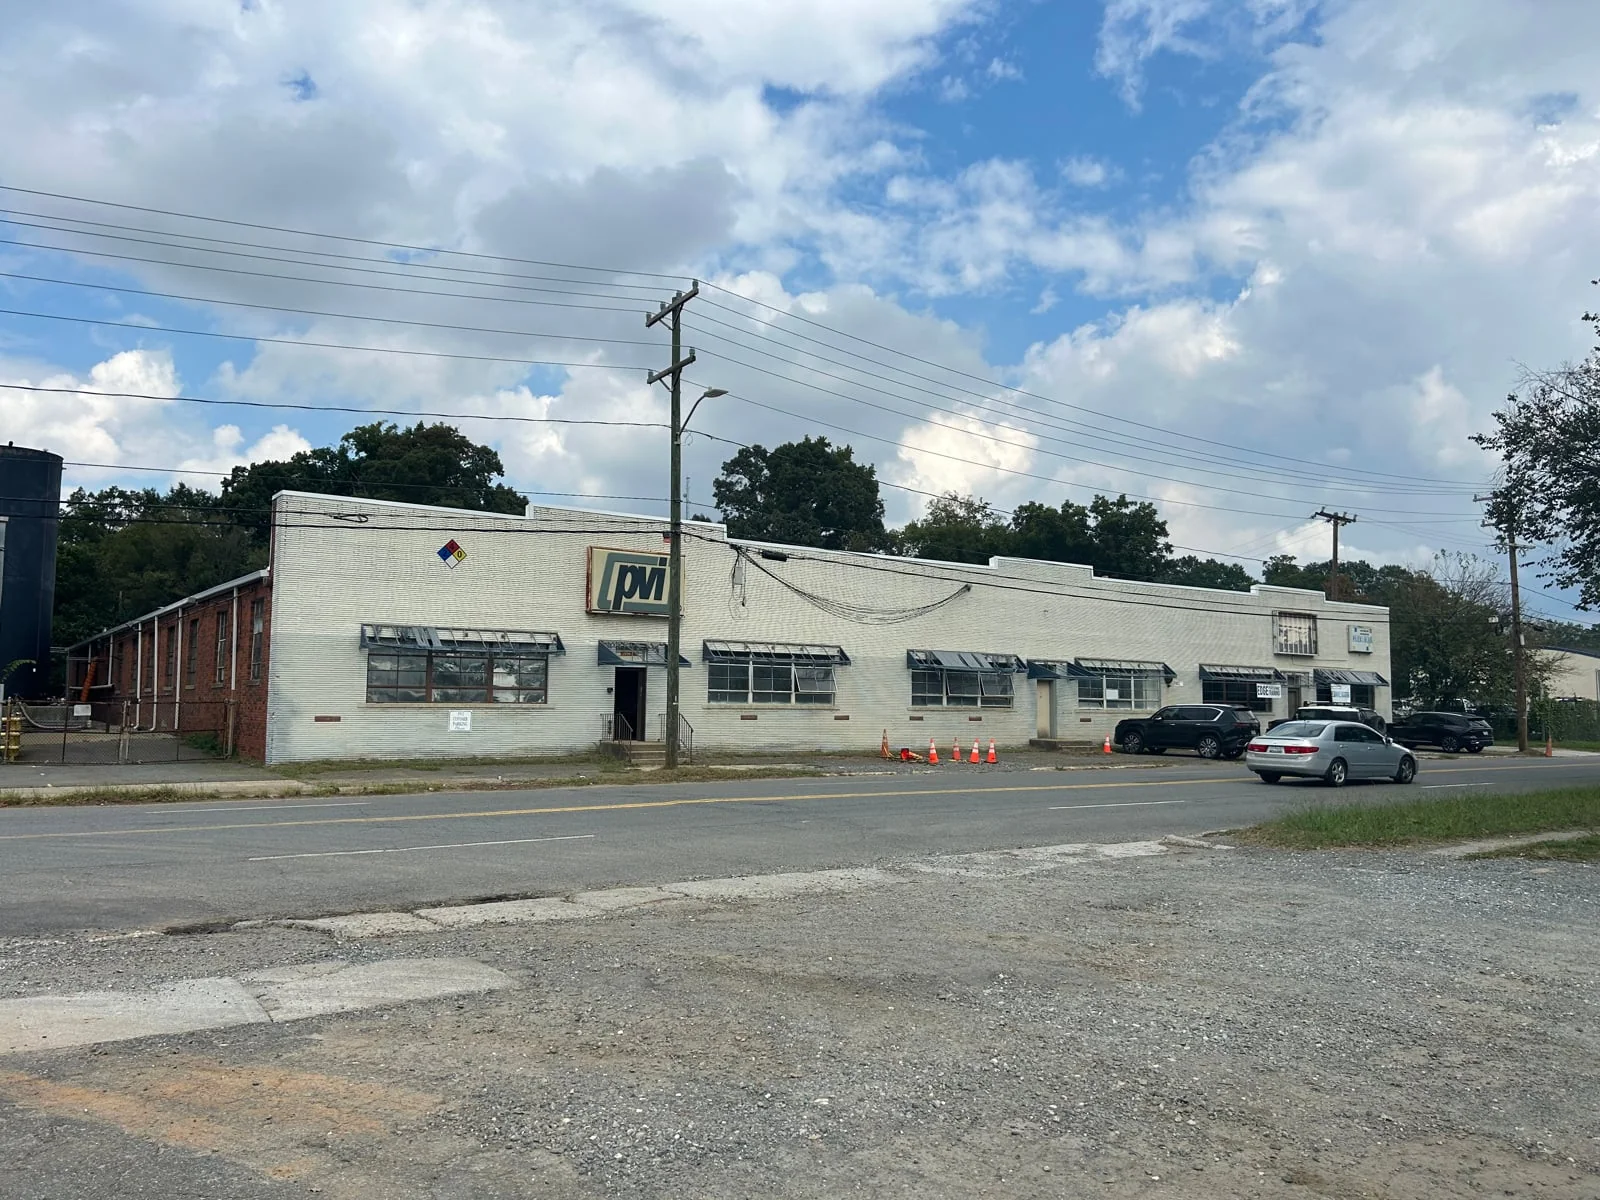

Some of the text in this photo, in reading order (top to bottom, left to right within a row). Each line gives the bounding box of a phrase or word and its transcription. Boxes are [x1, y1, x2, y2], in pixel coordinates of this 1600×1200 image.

[457, 550, 463, 558] 0
[612, 557, 667, 610] pvi
[1257, 685, 1269, 696] EDGE
